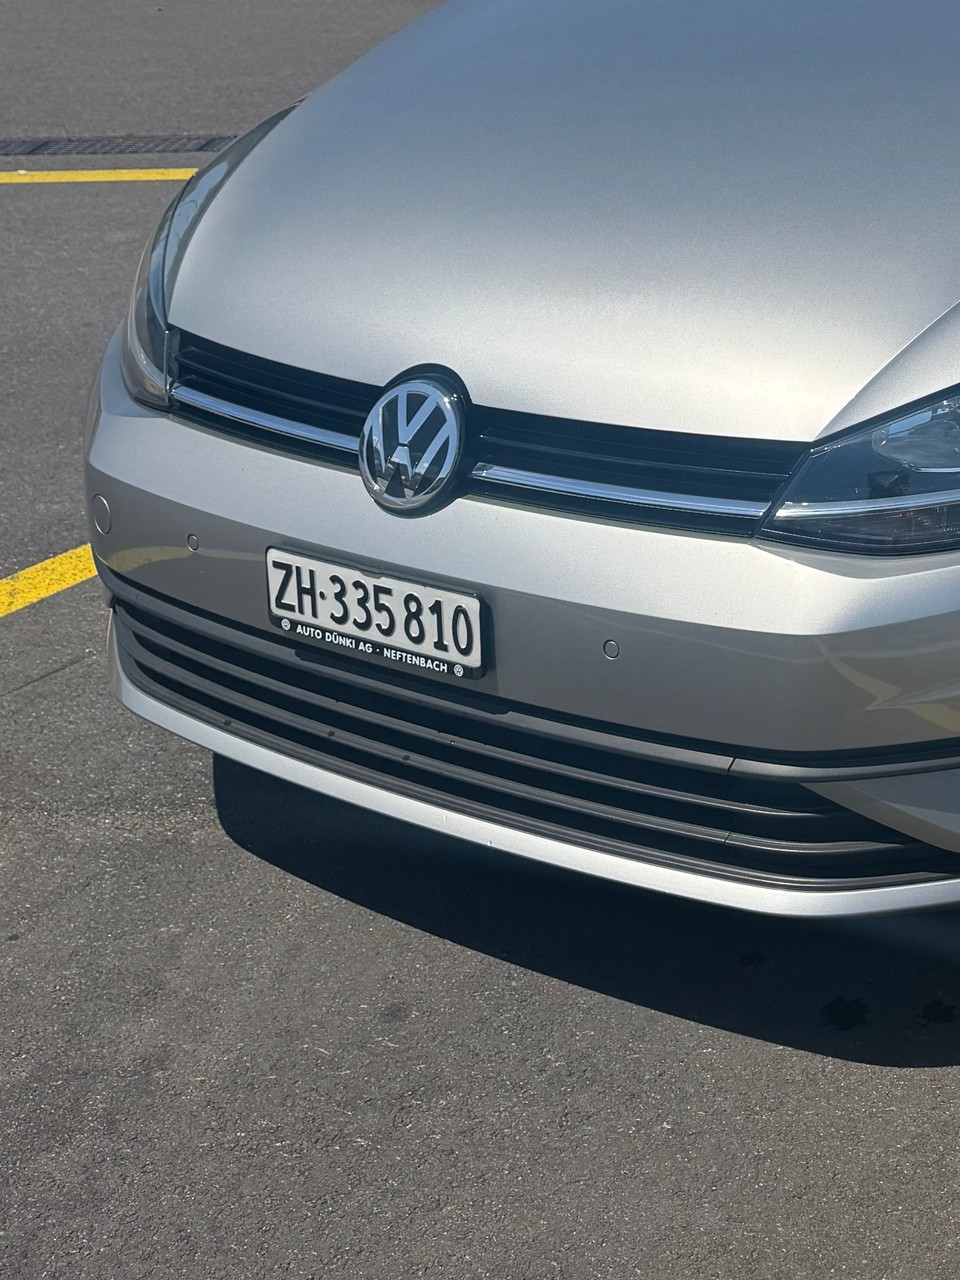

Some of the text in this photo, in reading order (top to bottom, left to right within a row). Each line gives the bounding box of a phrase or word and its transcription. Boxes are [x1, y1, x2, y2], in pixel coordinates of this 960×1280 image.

[296, 624, 322, 640] AUTO
[325, 632, 355, 649] DÜNKI
[358, 640, 373, 653] AG
[383, 647, 448, 673] NEFTENBACH
